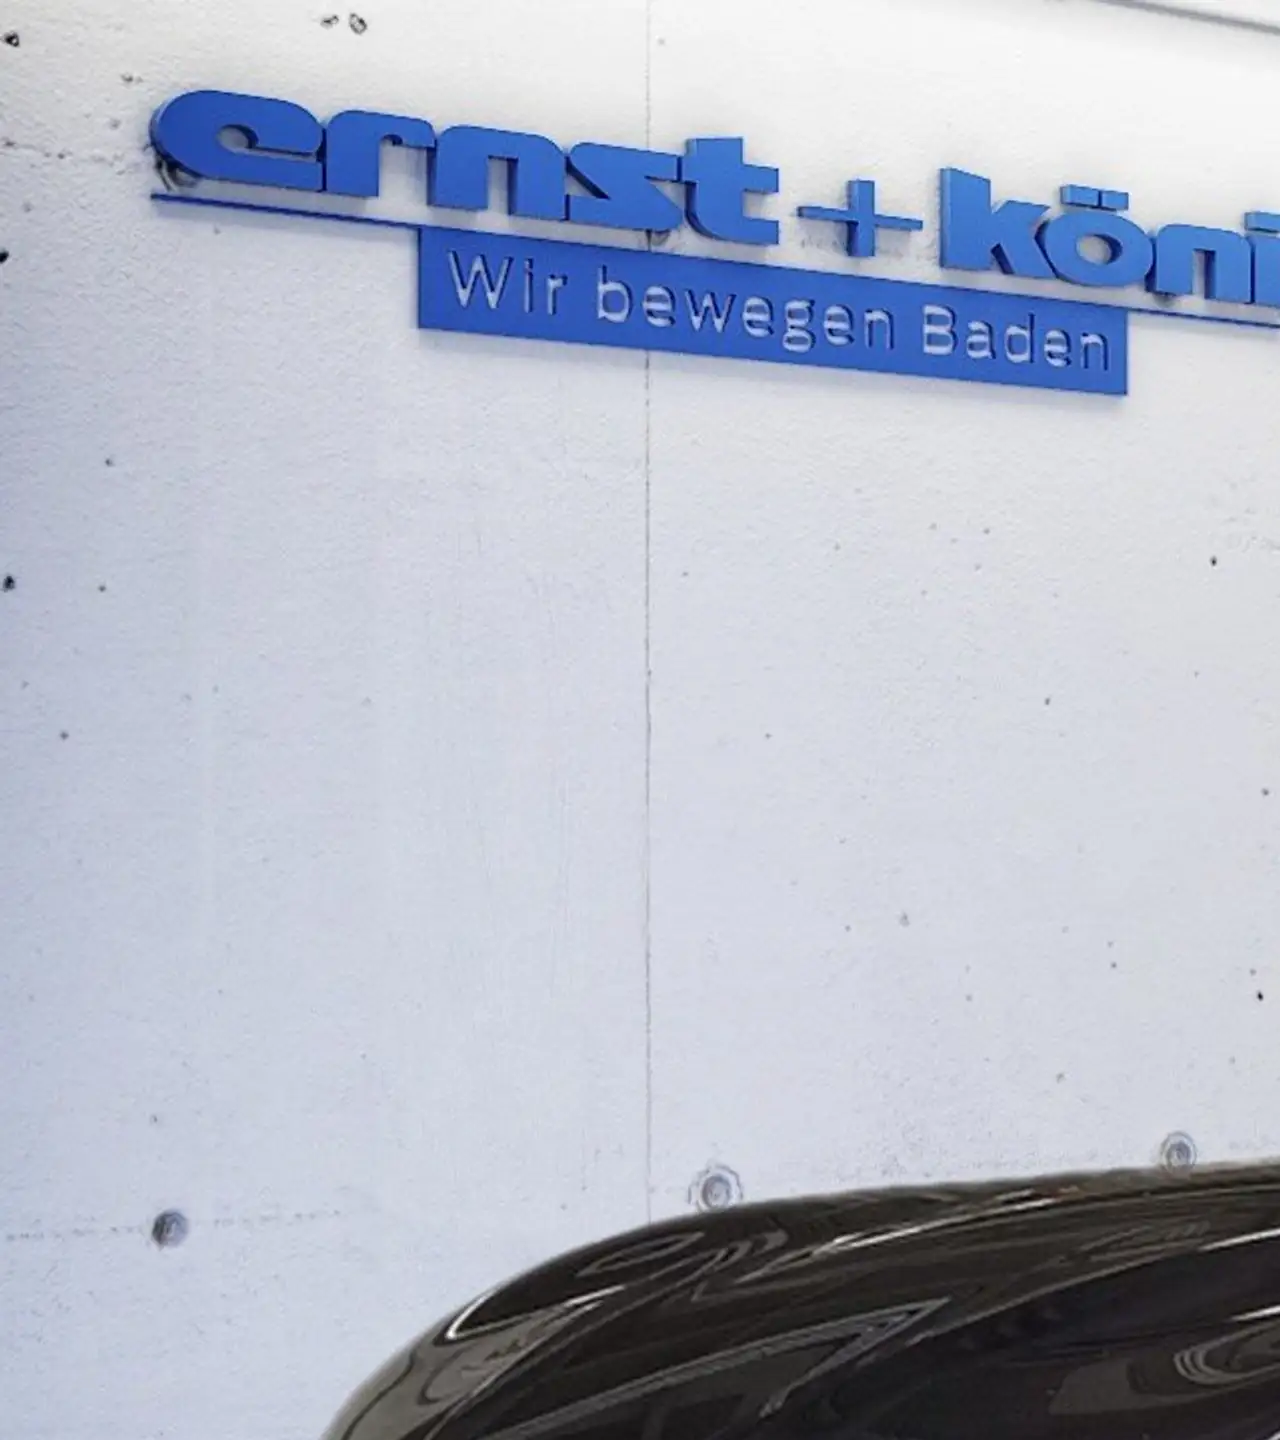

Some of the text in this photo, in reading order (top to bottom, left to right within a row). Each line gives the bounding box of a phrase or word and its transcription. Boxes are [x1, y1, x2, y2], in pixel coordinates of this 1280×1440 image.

[152, 90, 779, 246] ernst
[448, 253, 1113, 372] Wir bewegen Baden
